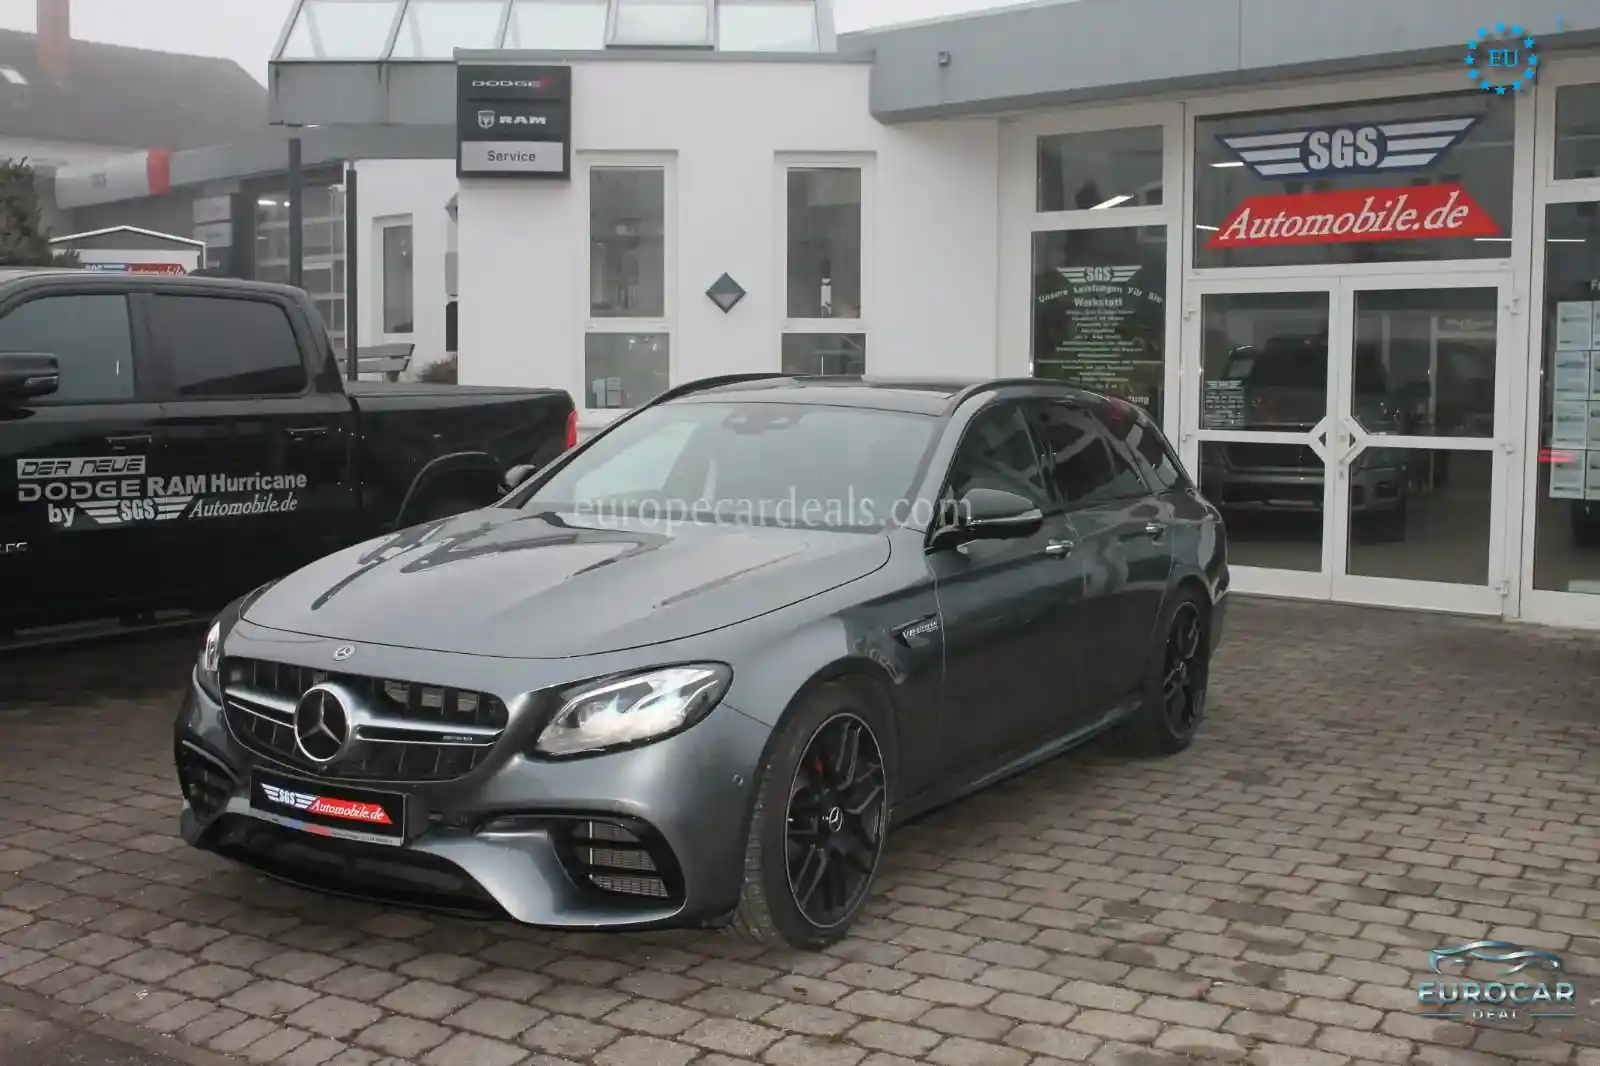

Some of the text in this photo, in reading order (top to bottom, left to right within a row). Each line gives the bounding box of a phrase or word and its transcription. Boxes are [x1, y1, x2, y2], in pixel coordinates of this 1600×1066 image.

[499, 115, 547, 125] RAM
[487, 150, 537, 162] Service
[1307, 127, 1379, 171] SGS
[1219, 188, 1469, 241] Automobile.de
[1085, 266, 1112, 282] SGS
[1073, 297, 1123, 307] Werkstatt
[21, 457, 144, 476] DER NEUE
[18, 472, 307, 501] DODGE RAM Hurricane
[48, 492, 298, 527] by SGS Automobile.de
[279, 789, 385, 821] SGS Automobile.de
